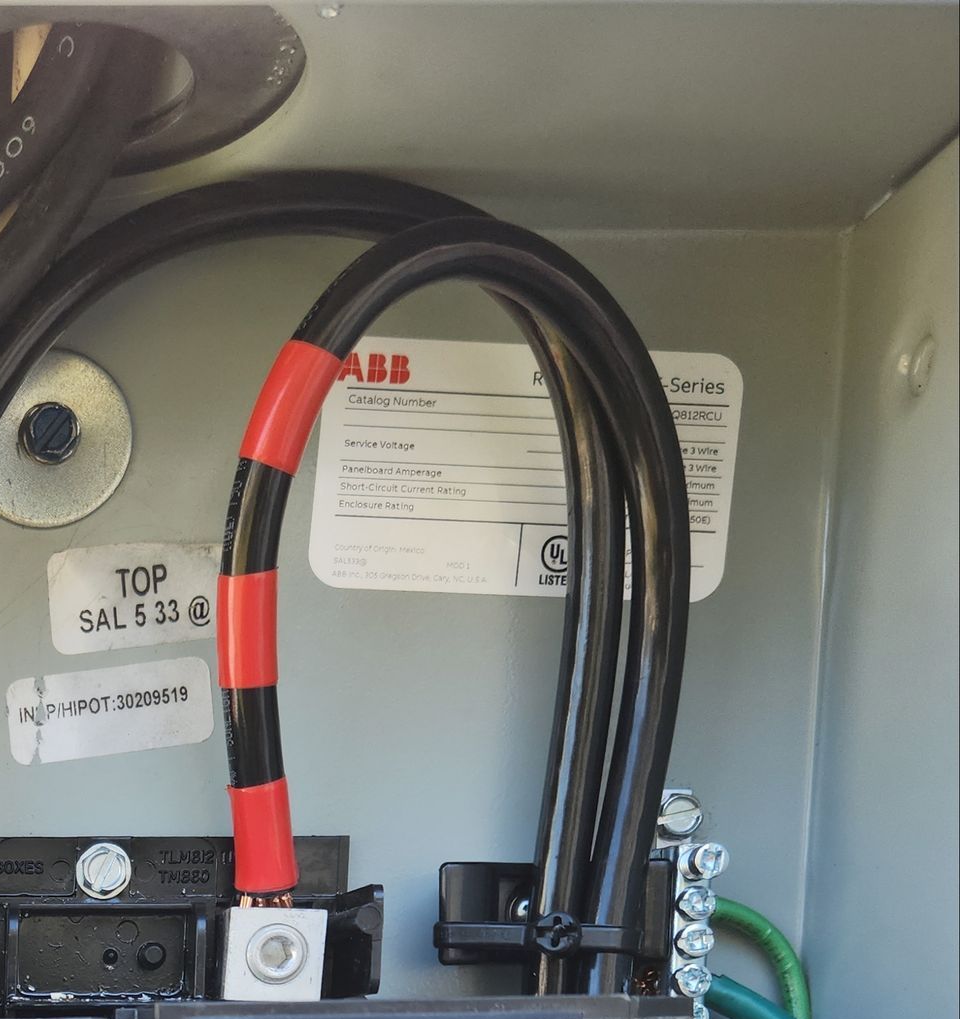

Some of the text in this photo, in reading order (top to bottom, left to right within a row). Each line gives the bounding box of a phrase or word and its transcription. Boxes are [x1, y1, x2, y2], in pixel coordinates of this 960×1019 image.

[338, 352, 411, 385] ABB
[348, 394, 438, 409] Catalog Number
[344, 439, 415, 452] Service Voltage
[697, 447, 719, 457] Wire
[342, 465, 442, 478] Panelboard Amperage
[695, 464, 717, 474] Wire
[340, 482, 467, 497] Short-Circuit Current Rating
[338, 499, 415, 512] Enclosure Rating
[334, 543, 364, 555] Country
[399, 546, 425, 555] Mexico
[115, 563, 168, 598] TOP
[332, 570, 347, 578] ABB
[539, 574, 568, 587] LISTE
[79, 605, 127, 634] SAL
[188, 595, 211, 627] @
[19, 685, 189, 724] INP/HIPOT:30209519
